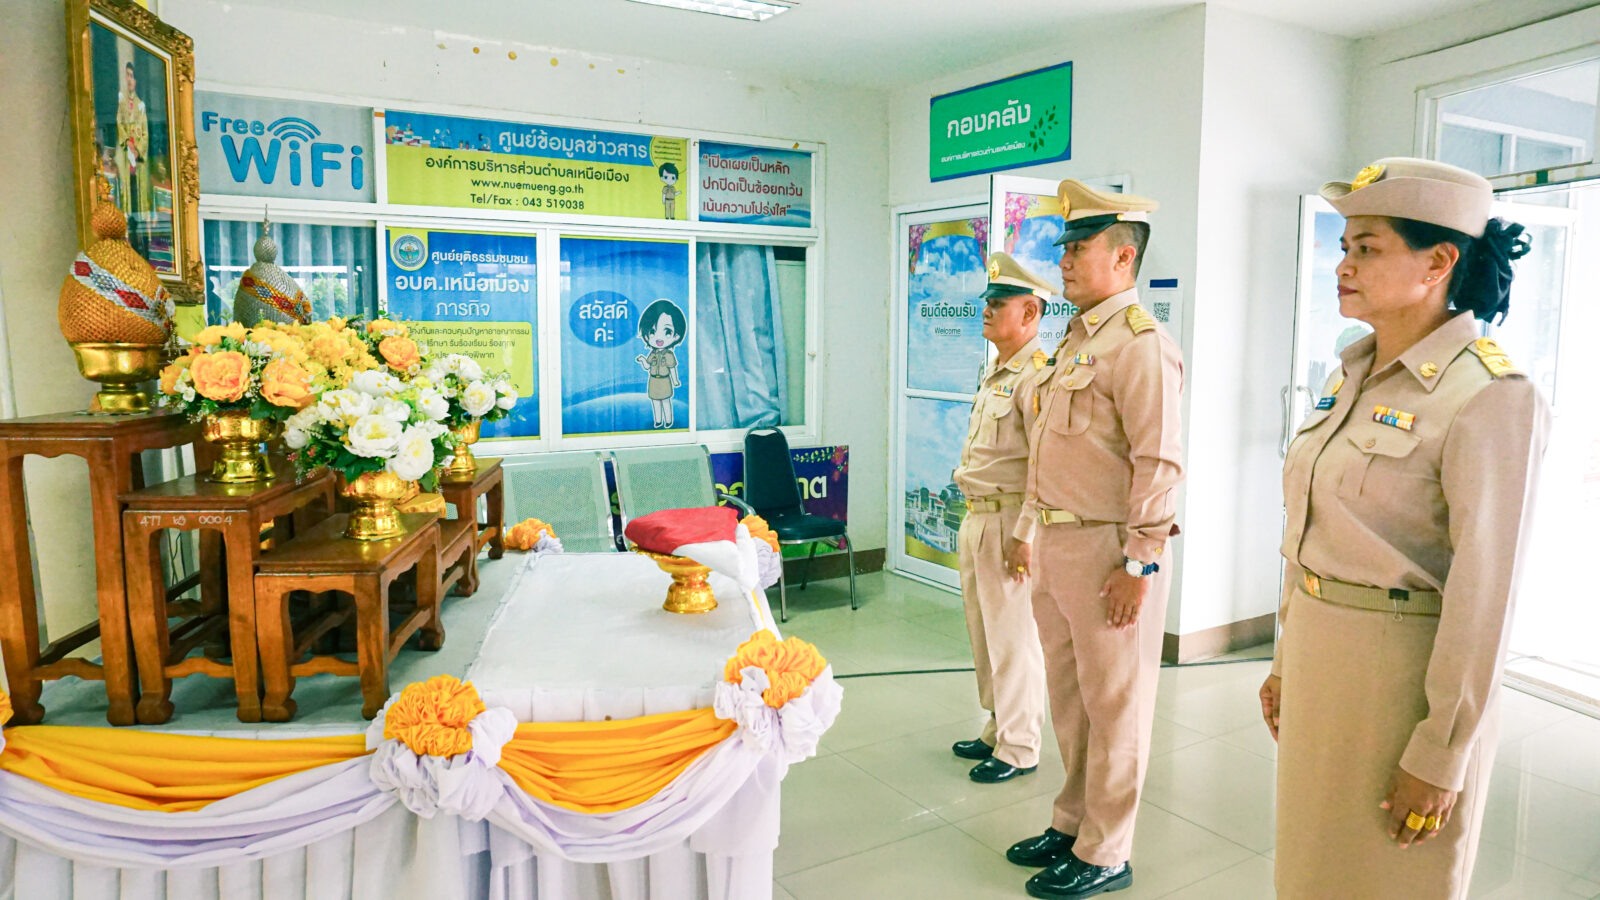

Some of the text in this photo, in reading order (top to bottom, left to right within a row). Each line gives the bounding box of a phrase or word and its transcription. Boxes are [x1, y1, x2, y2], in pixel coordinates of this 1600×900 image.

[202, 111, 265, 136] Free
[947, 99, 1031, 138] กองคลัง
[498, 128, 648, 159] ศูนย์ข้อมูลข่าวสาร
[220, 134, 364, 190] WiFi
[425, 155, 630, 183] องค์การบริหารส่วนตำบลเหนือเมือง
[471, 178, 584, 195] www.nuemueng.go.th
[702, 176, 803, 198] ปกปิดเป็นข้อยกเว้น
[470, 193, 512, 206] Tel/Fax
[521, 198, 545, 208] 043
[546, 199, 585, 210] 519038
[431, 249, 528, 267] ศูนย์ยุติธรรมชุมชน
[395, 272, 529, 293] อบต.เหนือเมือง
[435, 300, 491, 317] ภารกิจ
[579, 299, 628, 320] สวัสดี
[920, 301, 977, 318] ยินดีต้อนรับ
[594, 322, 614, 342] ค่ะ
[934, 327, 961, 336] Welcome
[1038, 330, 1053, 339] ion
